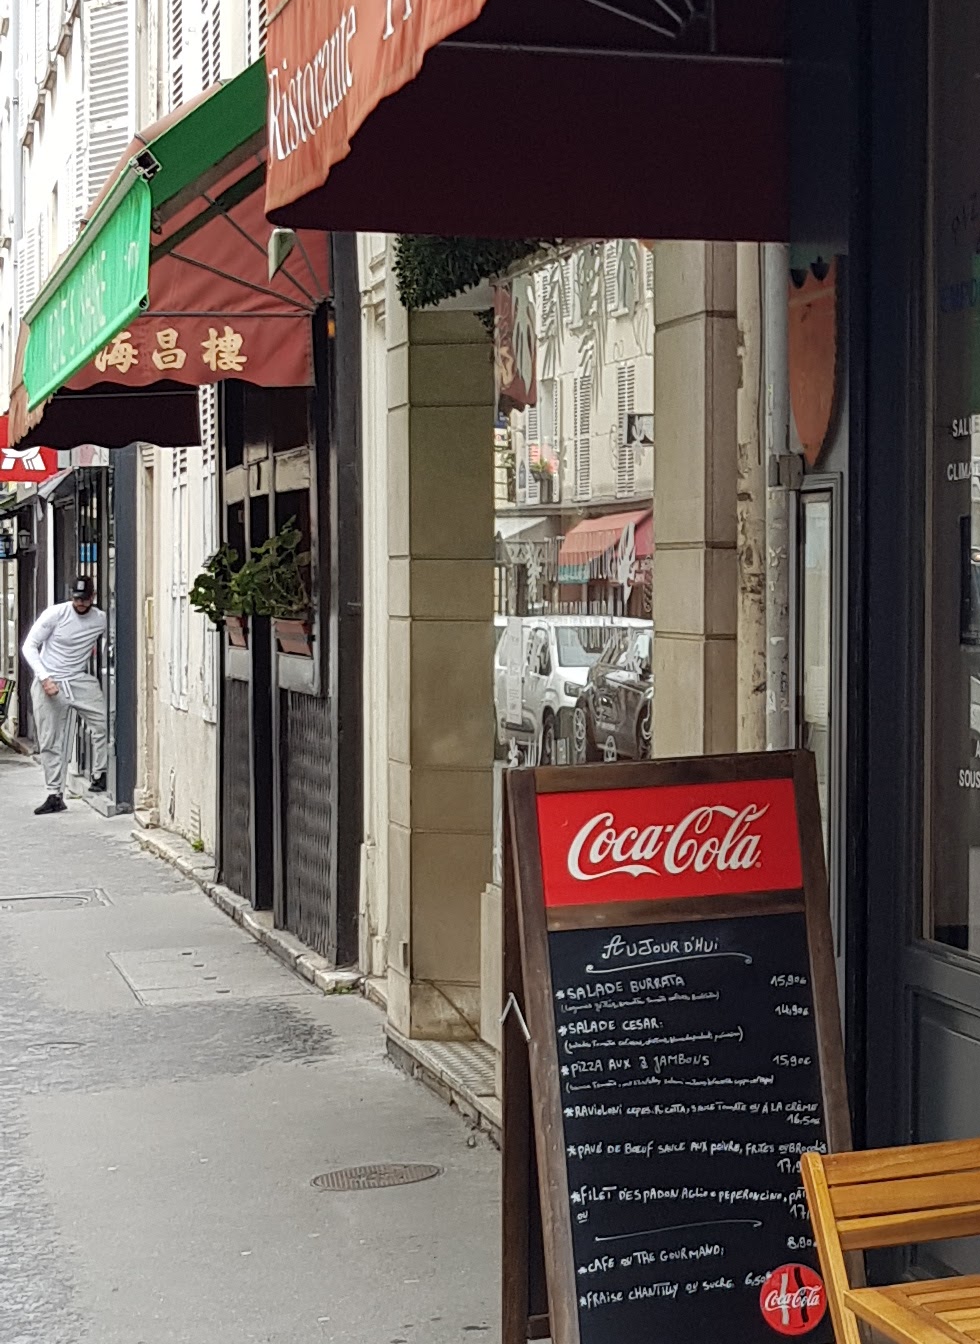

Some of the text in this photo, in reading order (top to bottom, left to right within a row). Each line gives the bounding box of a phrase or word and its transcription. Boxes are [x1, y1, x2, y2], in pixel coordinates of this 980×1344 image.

[268, 5, 357, 170] Ristorante
[567, 803, 771, 881] Coca-Cola
[566, 979, 624, 1000] SALADE
[630, 974, 685, 994] BURRATA
[568, 1018, 617, 1035] SALADE
[608, 1056, 632, 1070] AUX
[607, 1144, 621, 1155] DE
[764, 1284, 823, 1312] Coca-Cola
